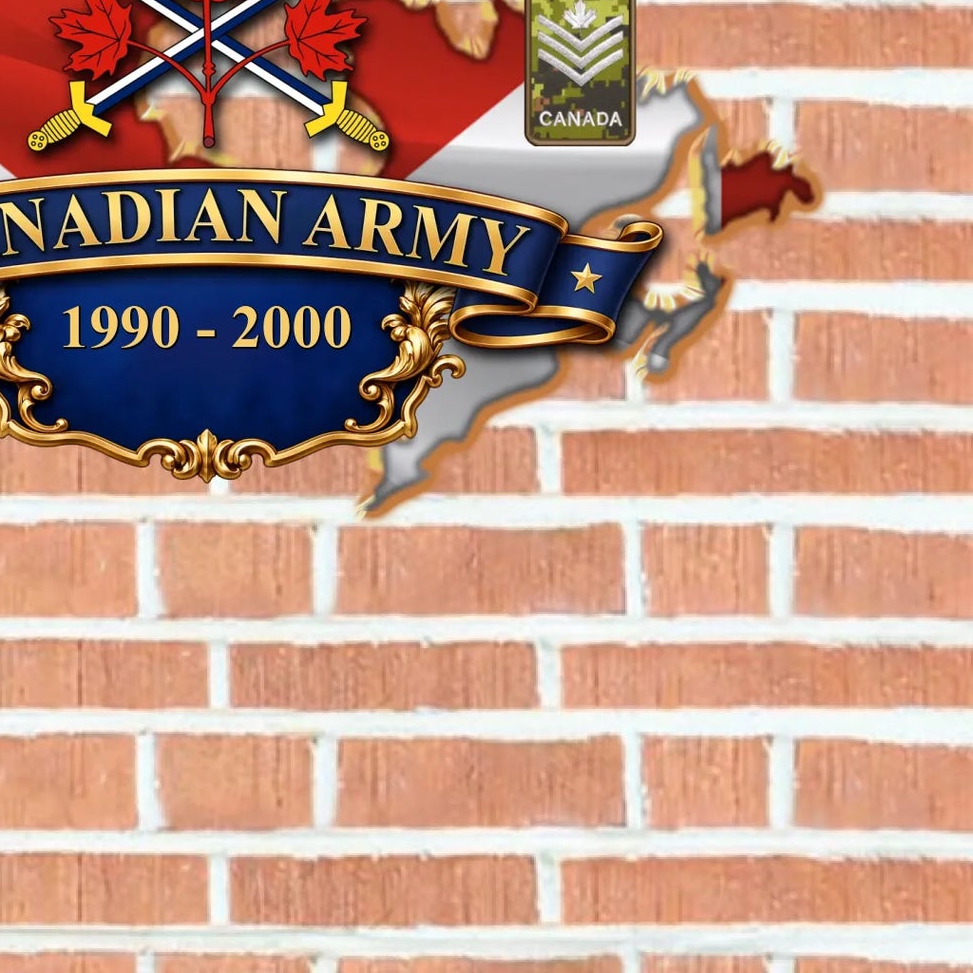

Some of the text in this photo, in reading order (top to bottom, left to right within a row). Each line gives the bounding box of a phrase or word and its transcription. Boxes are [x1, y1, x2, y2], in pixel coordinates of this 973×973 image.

[539, 110, 623, 127] CANADA
[303, 194, 531, 277] ARMY
[62, 304, 352, 350] 1990 - 2000
